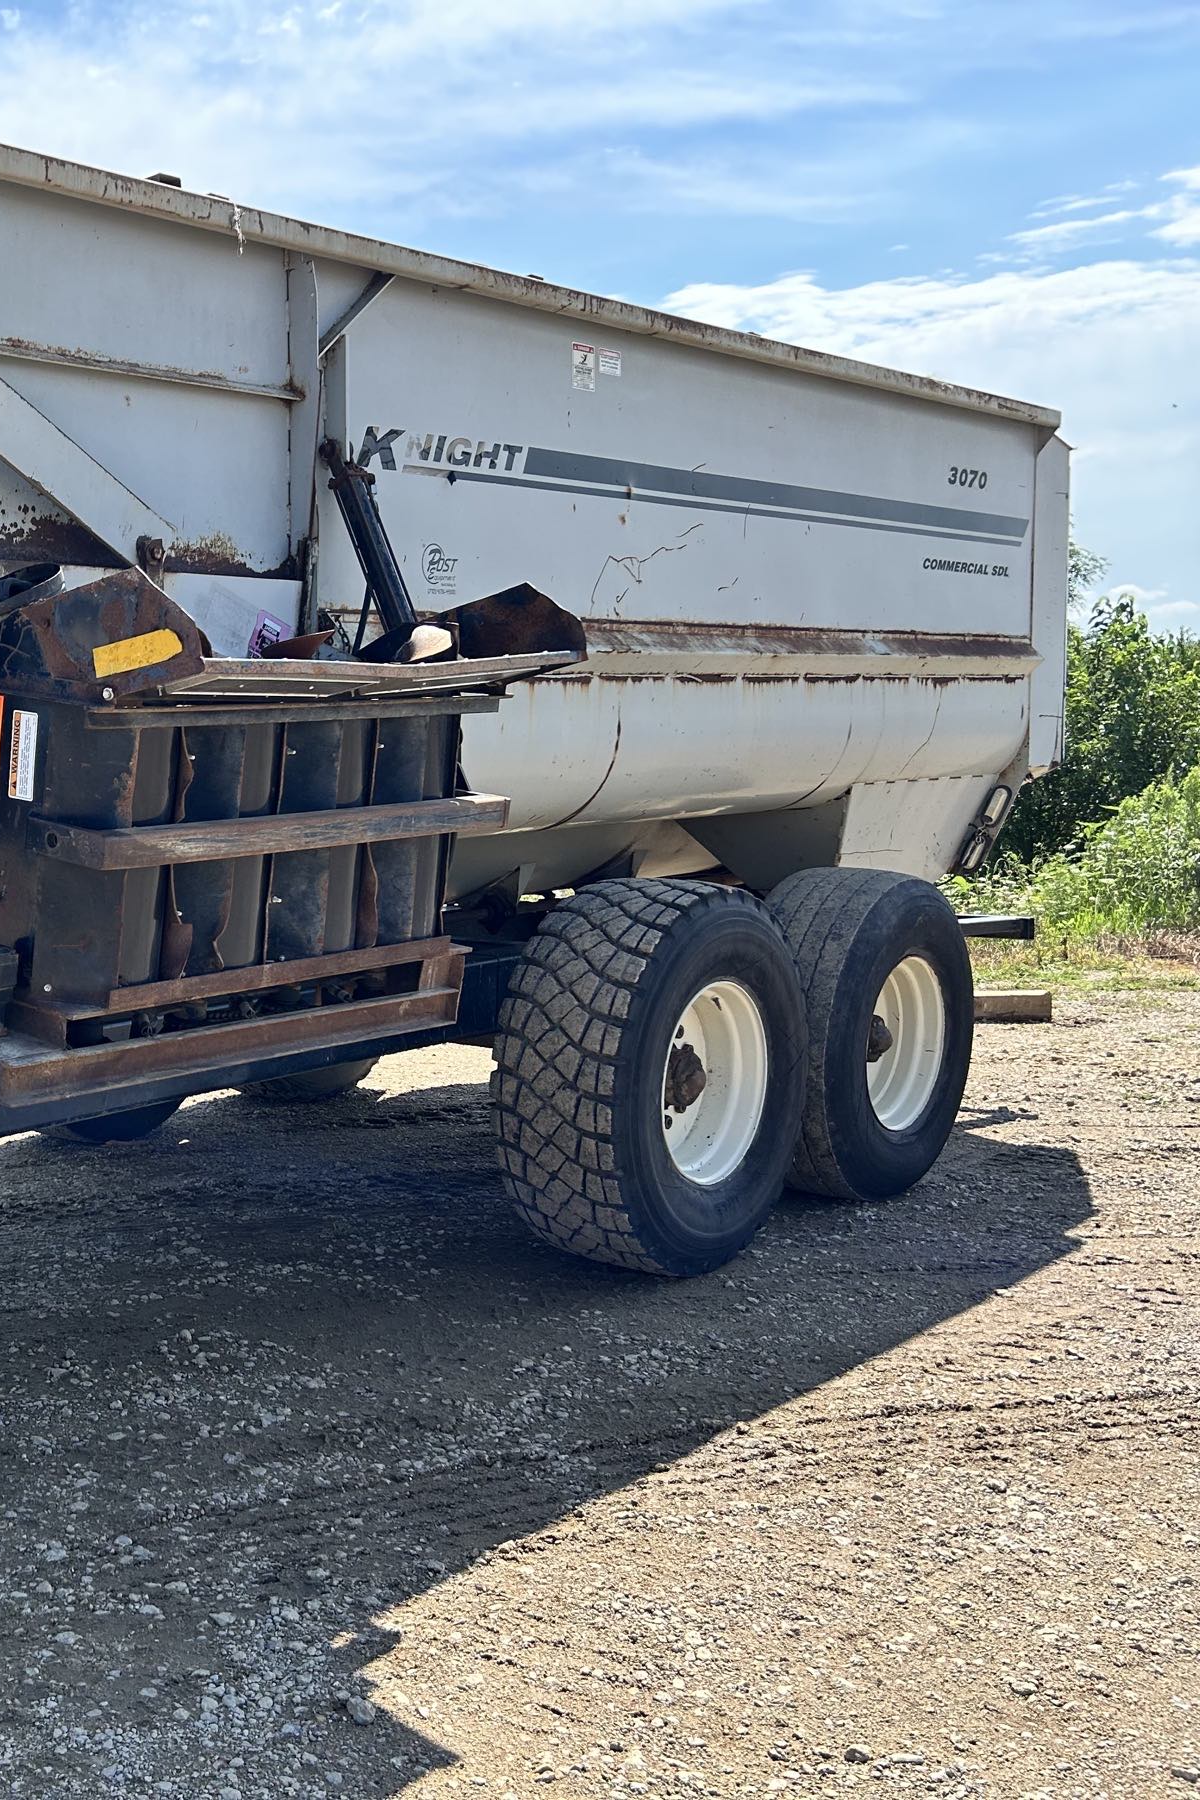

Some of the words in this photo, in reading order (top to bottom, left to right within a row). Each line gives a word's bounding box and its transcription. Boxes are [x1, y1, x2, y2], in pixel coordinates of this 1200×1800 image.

[356, 425, 523, 471] KNIGHT
[947, 466, 988, 490] 3070
[922, 558, 989, 575] COMMERCIAL
[991, 565, 1009, 577] SDL
[11, 719, 21, 774] WARNING
